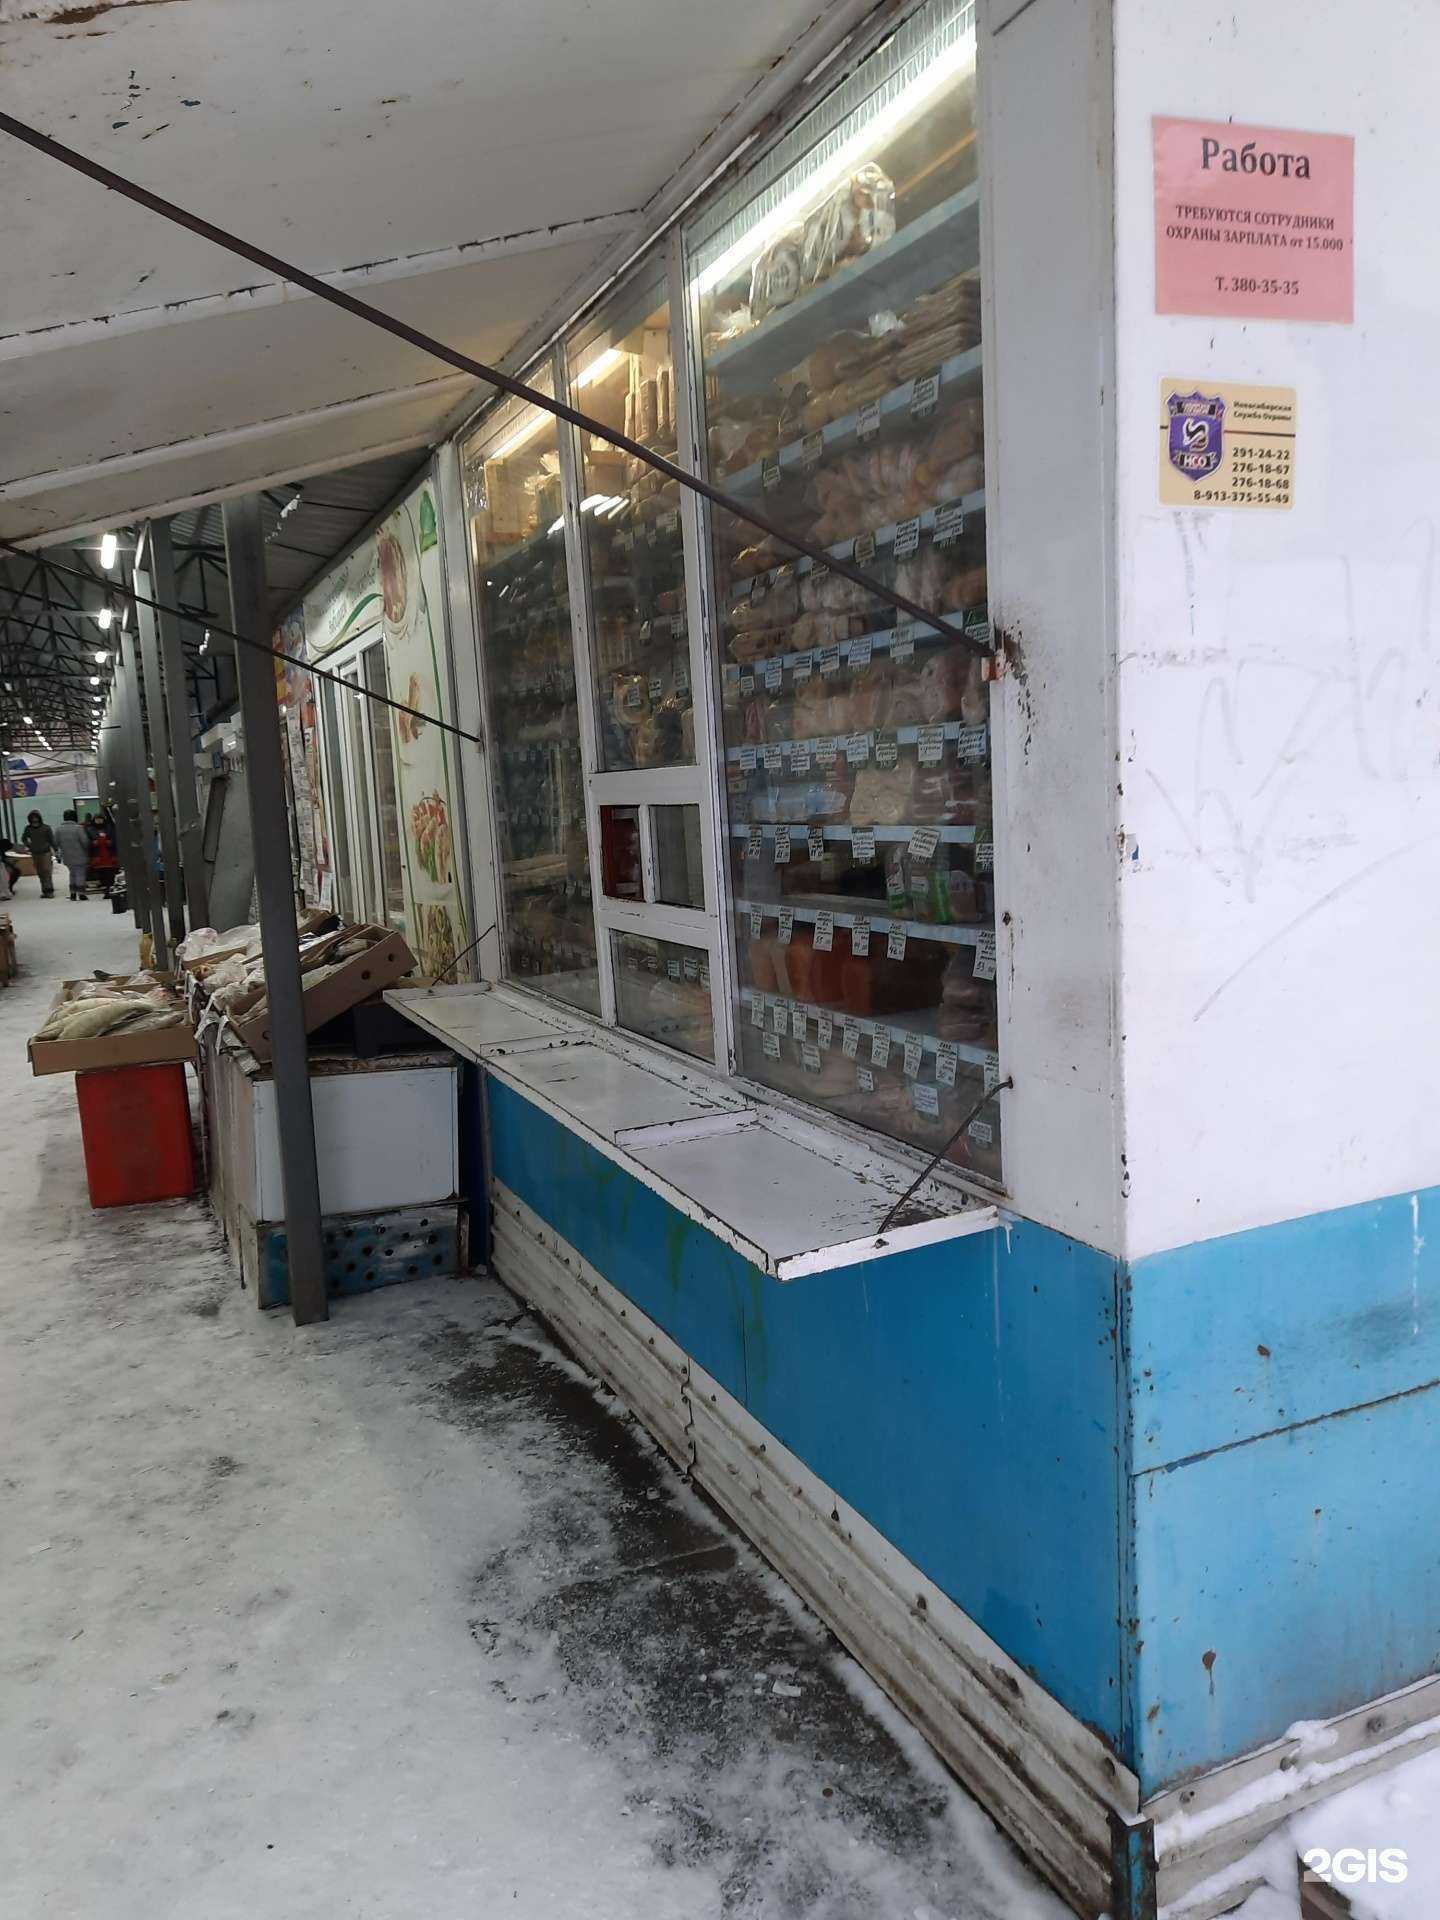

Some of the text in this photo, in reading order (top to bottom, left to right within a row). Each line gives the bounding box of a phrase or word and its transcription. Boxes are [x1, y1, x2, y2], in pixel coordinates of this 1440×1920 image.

[1200, 137, 1311, 180] Работа
[1175, 204, 1335, 230] ТРЕБУЮТСЯ СОТРУДНИКИ
[1166, 226, 1344, 251] ОХРАНЫ ЗАРПЛАТА от 15.000
[1231, 278, 1300, 295] 380-35-35
[1232, 447, 1290, 460] 291-24-22
[1232, 462, 1290, 475] 276-18-67
[1232, 477, 1290, 489] 276-18-68
[1193, 490, 1290, 504] 8-913-375-55-49
